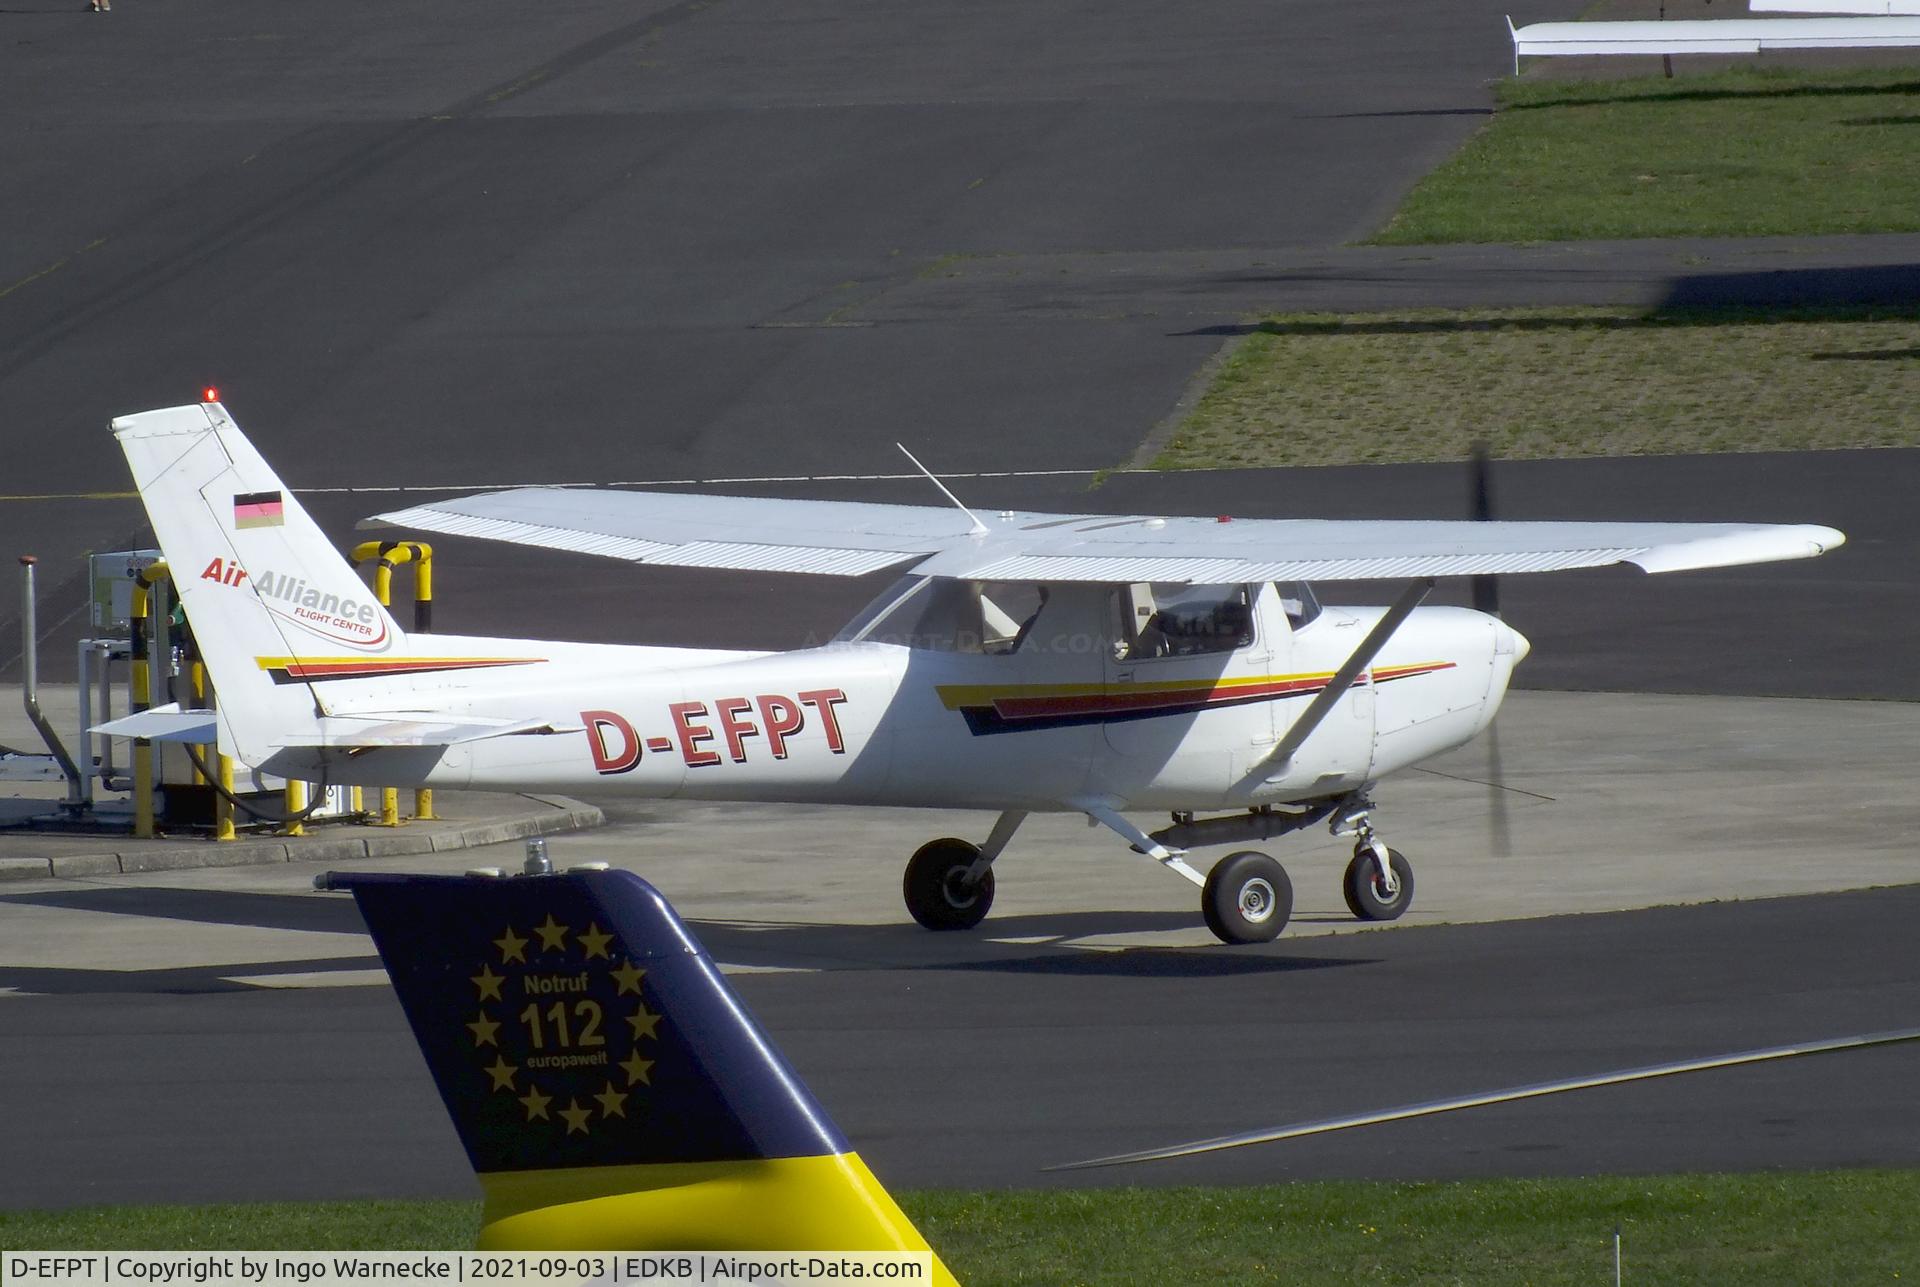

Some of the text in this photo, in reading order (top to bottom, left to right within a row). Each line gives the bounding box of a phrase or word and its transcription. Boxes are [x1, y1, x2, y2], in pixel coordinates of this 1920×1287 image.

[201, 557, 375, 624] Air Alliance
[294, 607, 373, 636] FLIGHT CENTER
[579, 688, 849, 776] D-EFPT
[524, 972, 588, 994] Notruf
[520, 1000, 605, 1049] 112
[527, 1052, 608, 1069] europaweit
